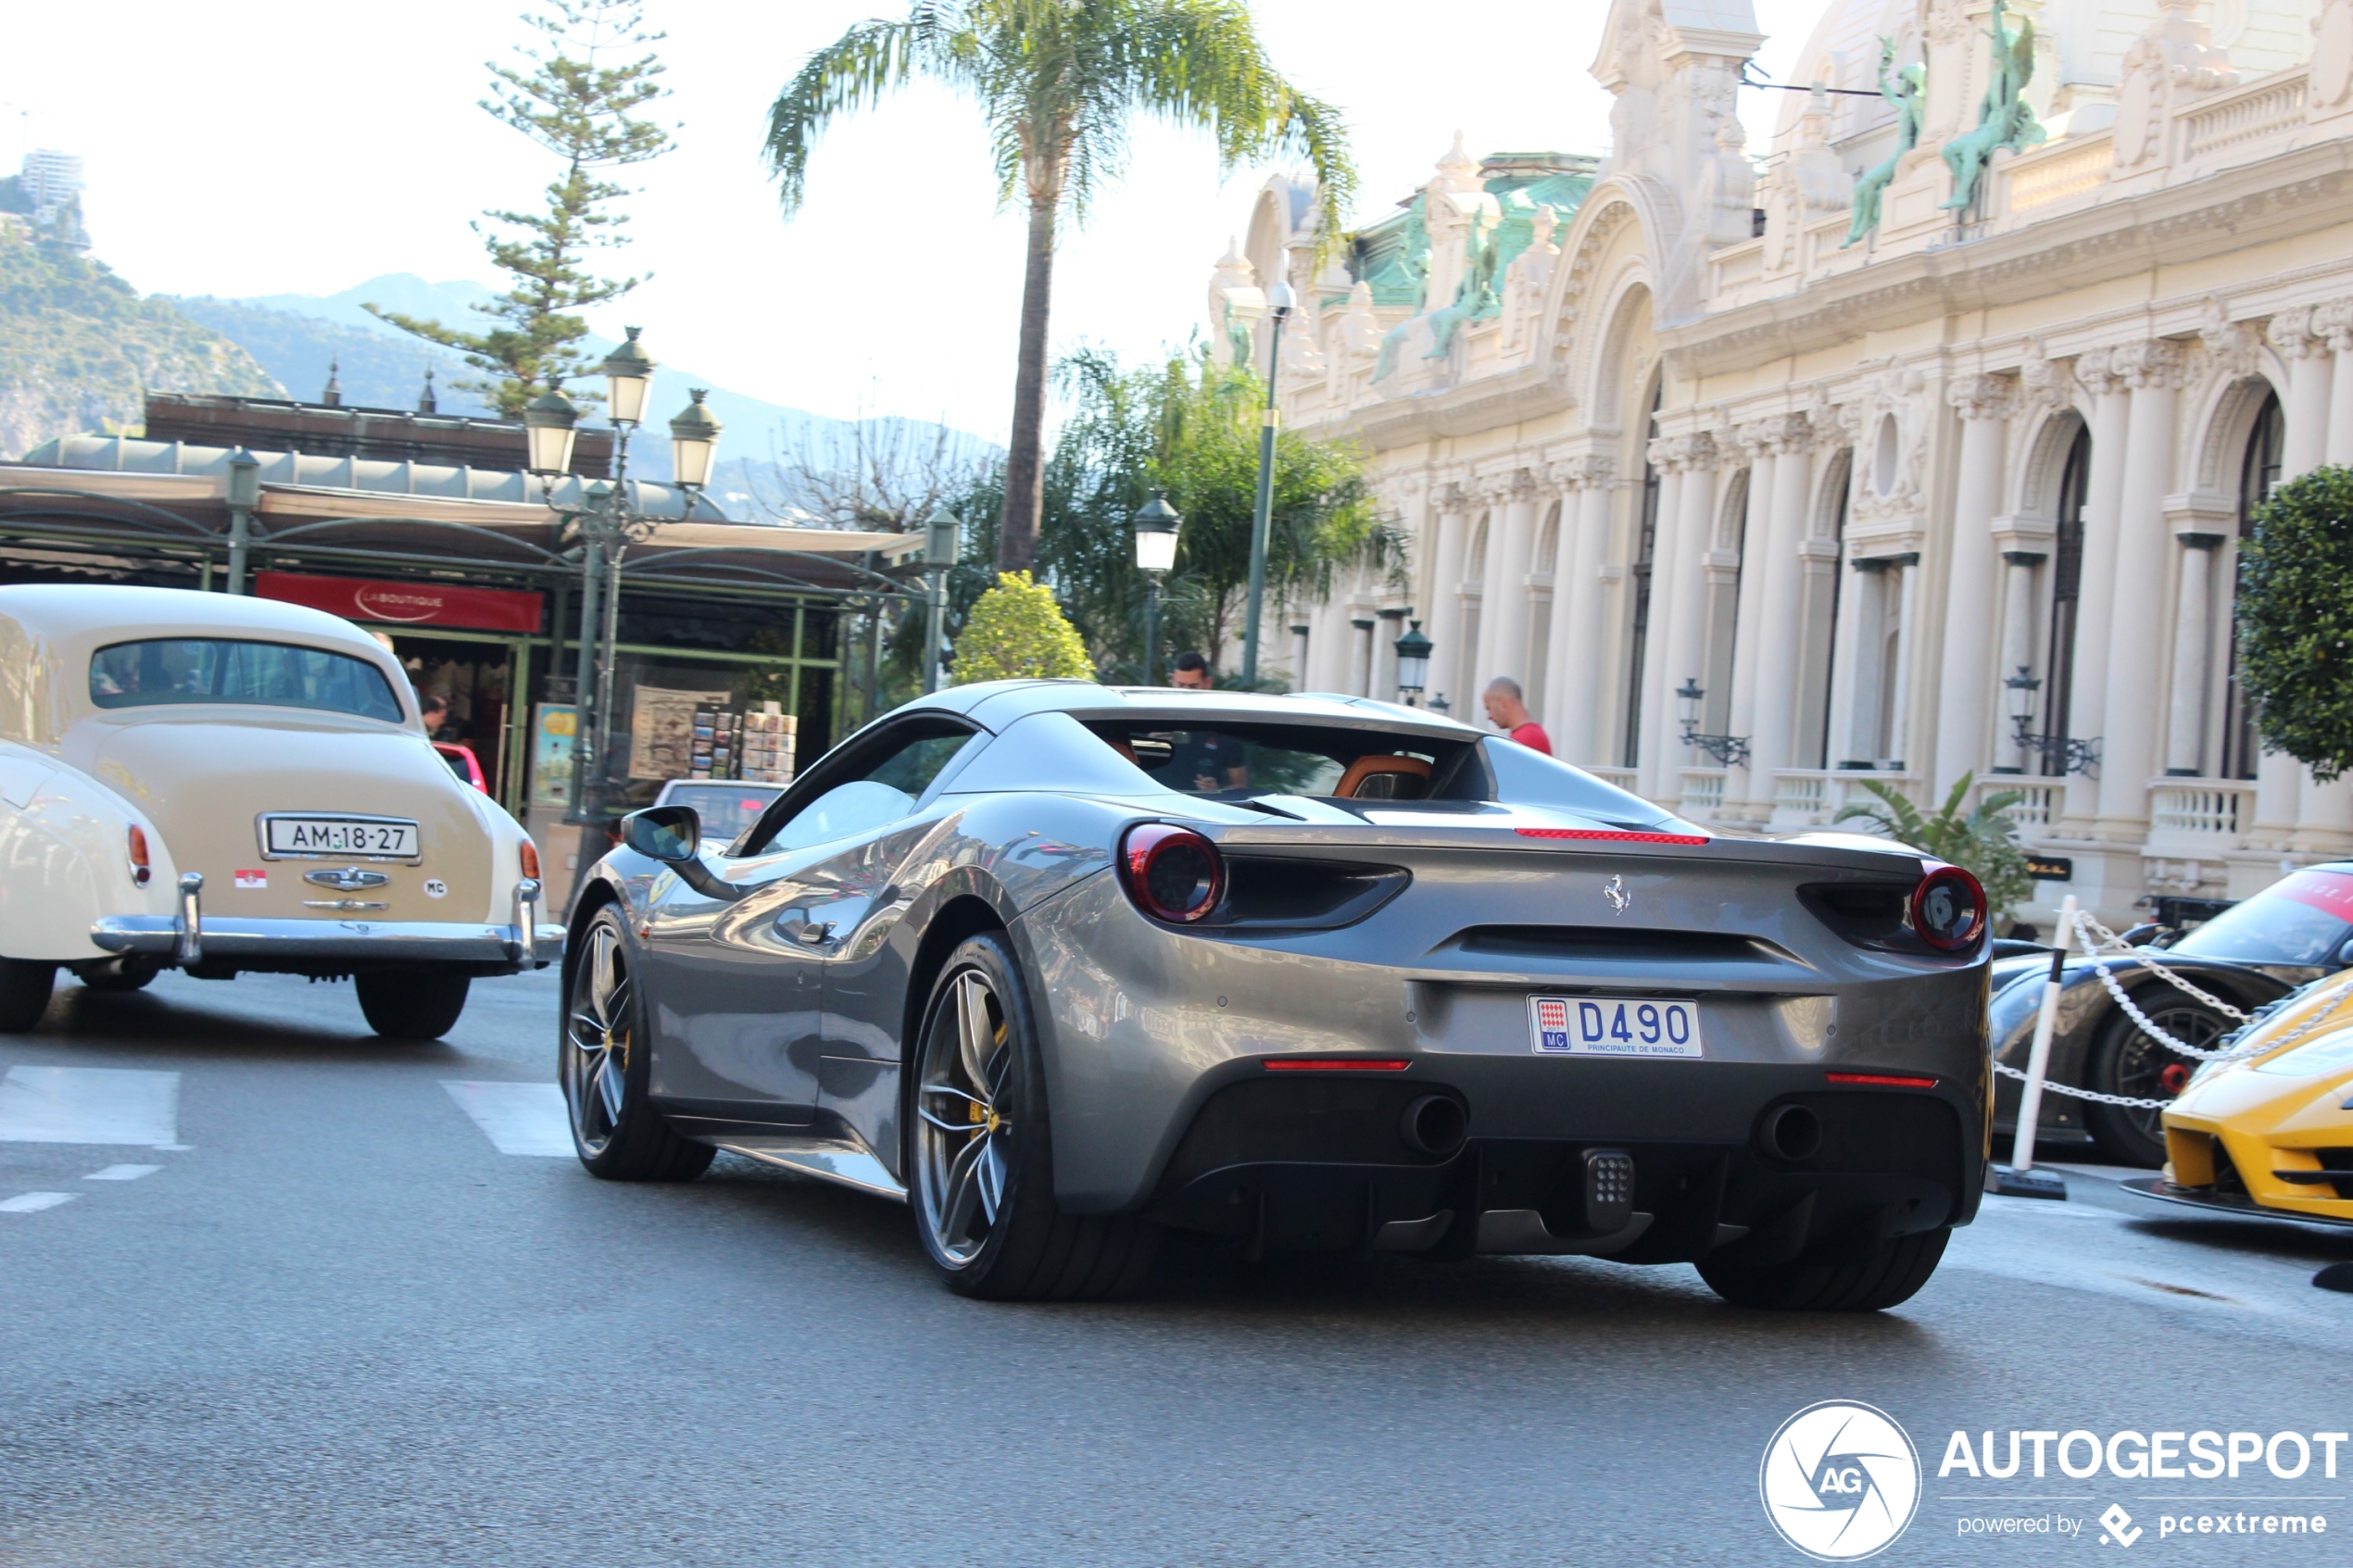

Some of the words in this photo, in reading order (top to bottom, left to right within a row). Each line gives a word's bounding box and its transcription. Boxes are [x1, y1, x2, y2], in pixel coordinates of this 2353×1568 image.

[293, 824, 406, 850] AM-18-27
[427, 883, 444, 894] MC
[1579, 1002, 1690, 1045] D490
[1546, 1034, 1565, 1047] MC
[1587, 1044, 1637, 1053] PRINCIPAUTE
[1652, 1046, 1685, 1054] MONACO
